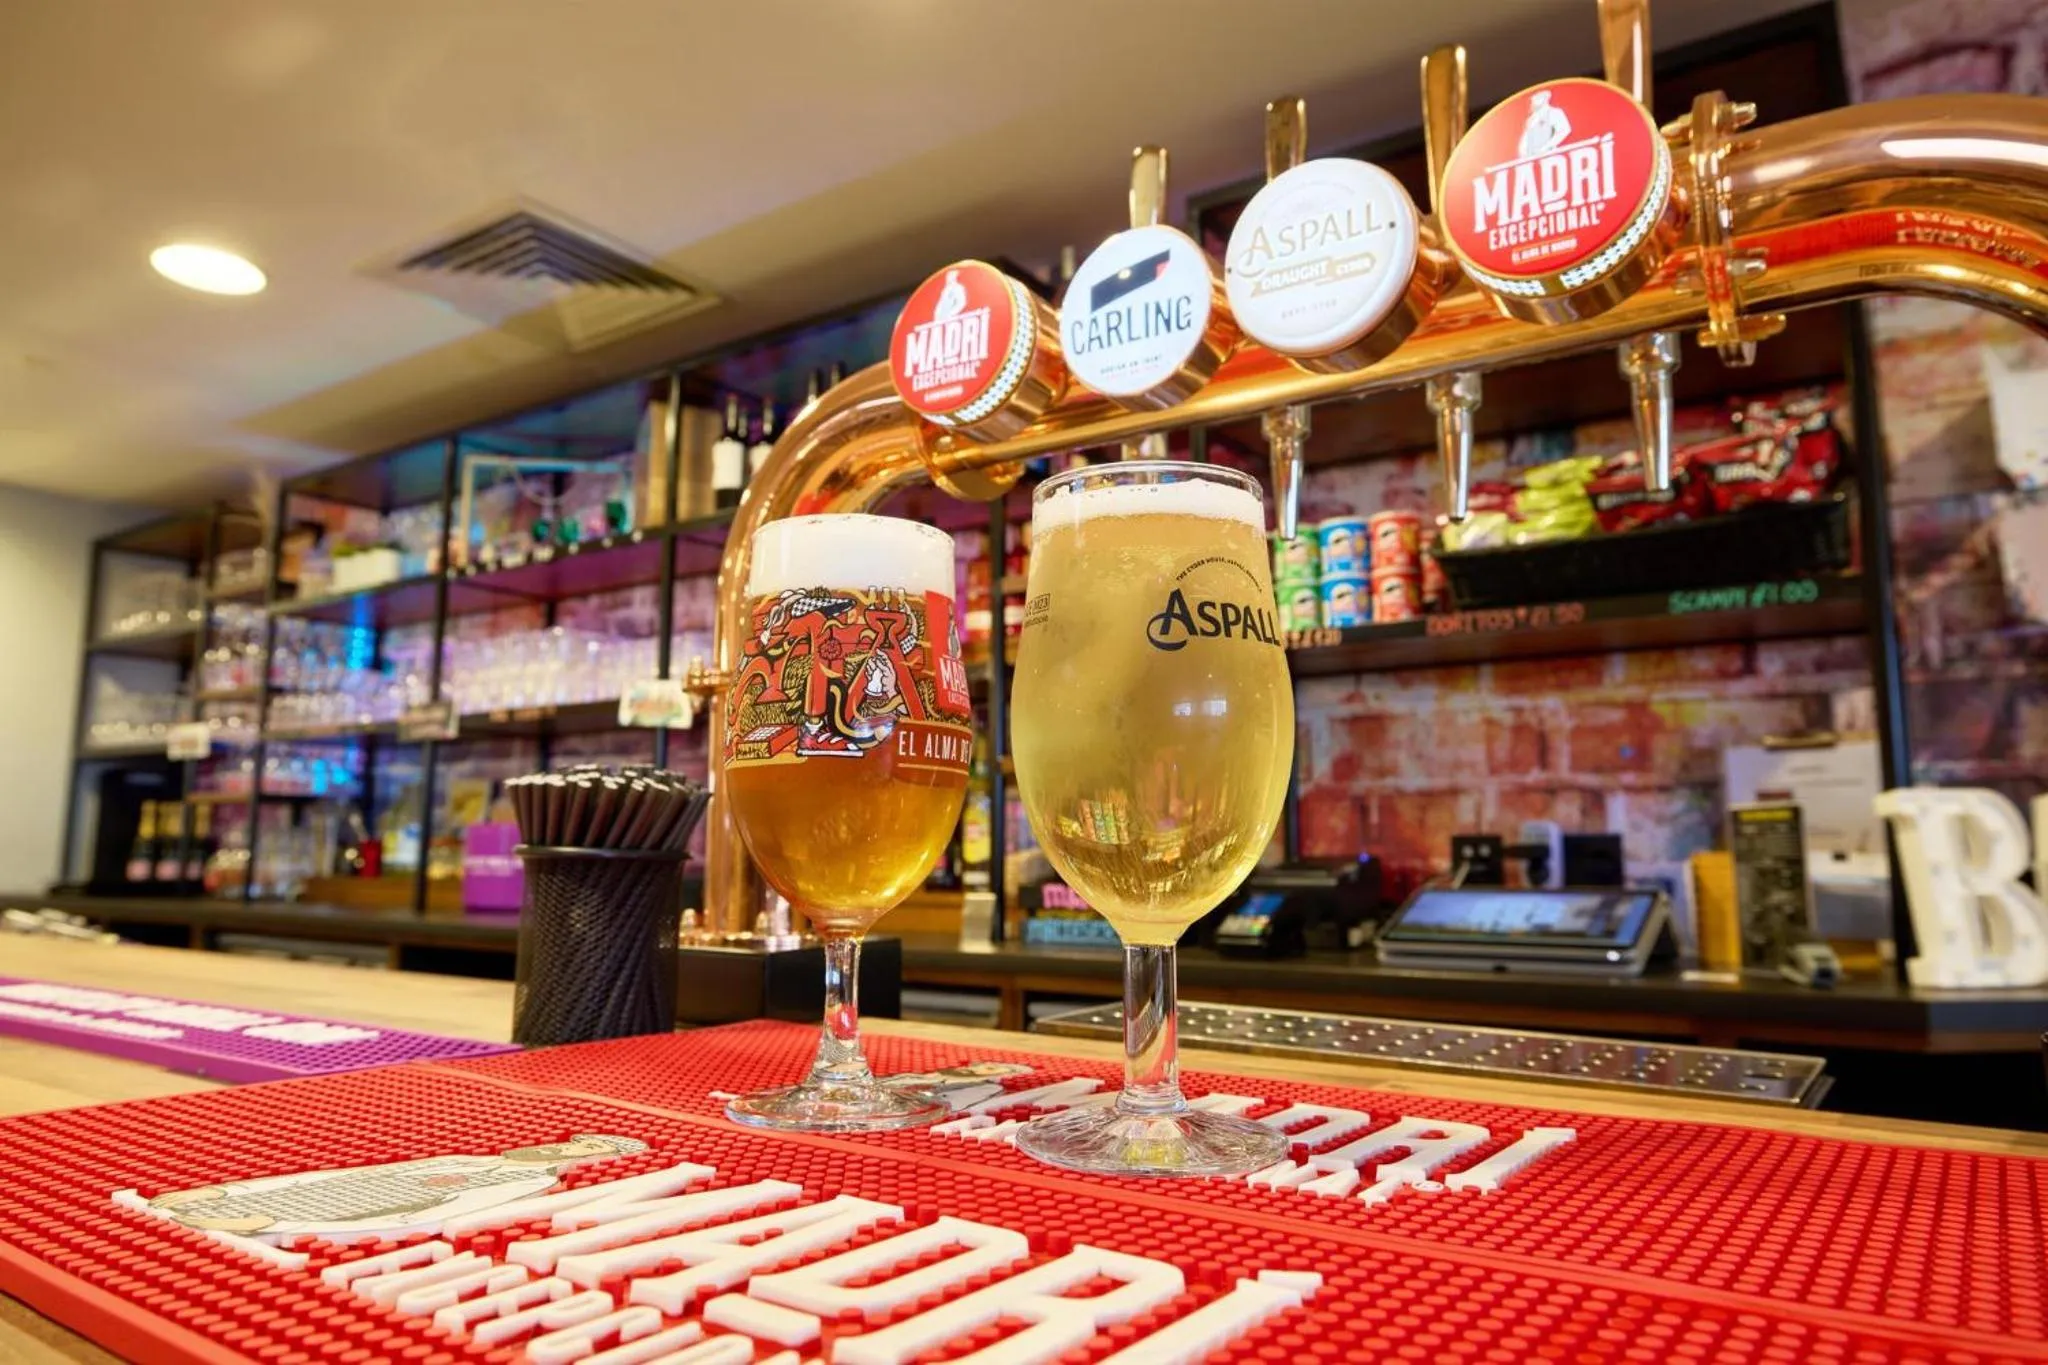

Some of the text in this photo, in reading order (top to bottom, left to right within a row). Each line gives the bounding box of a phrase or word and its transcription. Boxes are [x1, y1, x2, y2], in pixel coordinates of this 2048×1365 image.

[1260, 260, 1329, 291] DRAUGHT
[1070, 294, 1193, 356] CARLING
[1147, 588, 1281, 651] ASPALL
[899, 731, 916, 756] EL
[924, 733, 957, 760] ALMA
